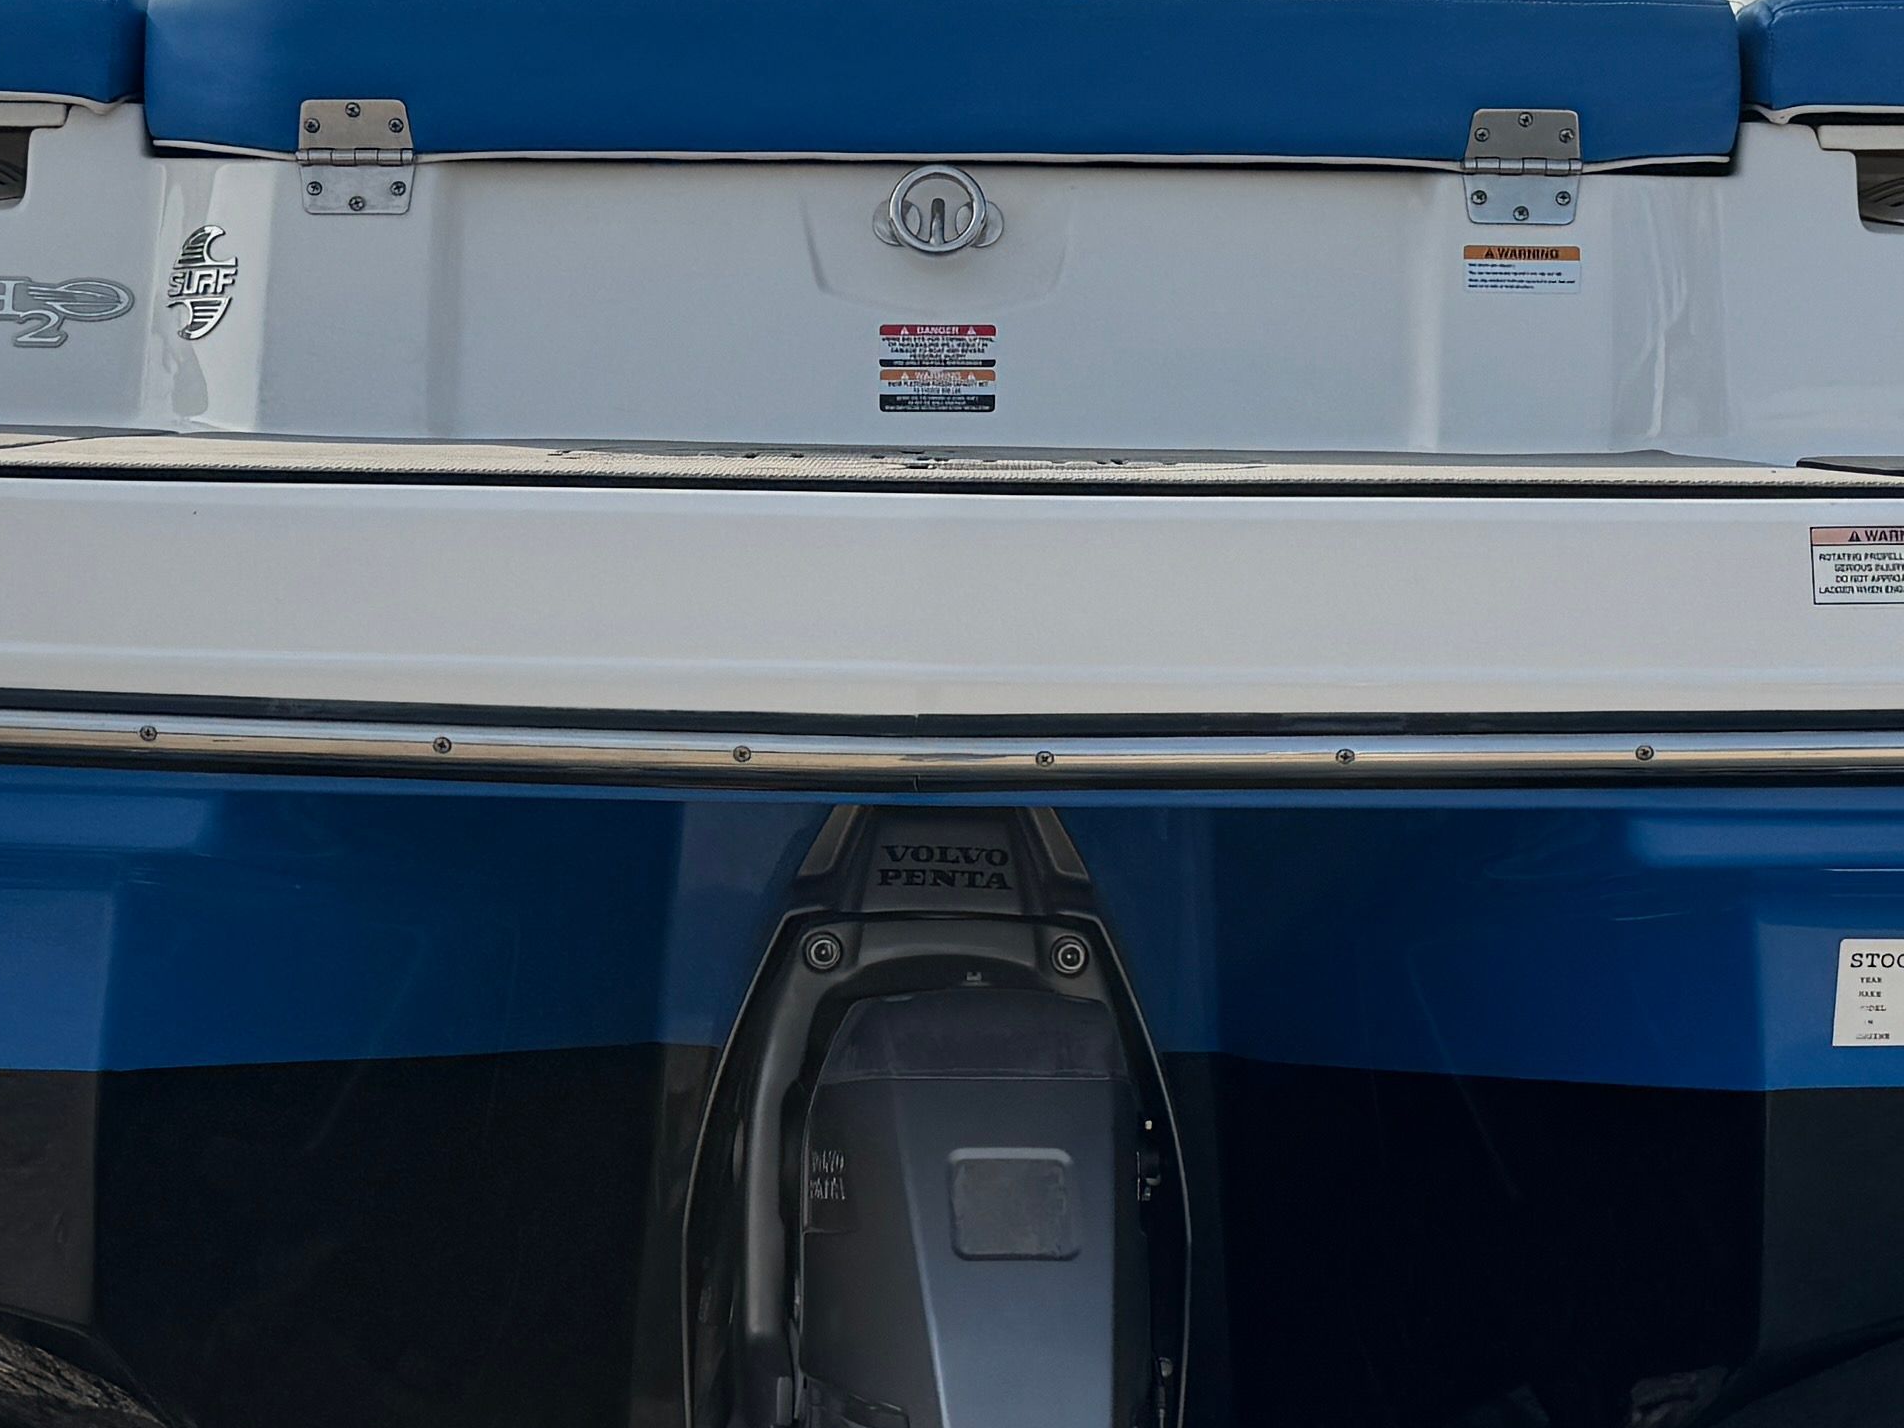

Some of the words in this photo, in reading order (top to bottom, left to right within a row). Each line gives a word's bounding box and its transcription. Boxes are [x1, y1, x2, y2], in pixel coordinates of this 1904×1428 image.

[167, 269, 238, 297] SURF
[916, 326, 960, 335] DANGER
[1835, 575, 1848, 583] DO
[1850, 575, 1868, 583] NOT
[881, 844, 1009, 867] VOLVO
[877, 869, 1013, 890] PENTA
